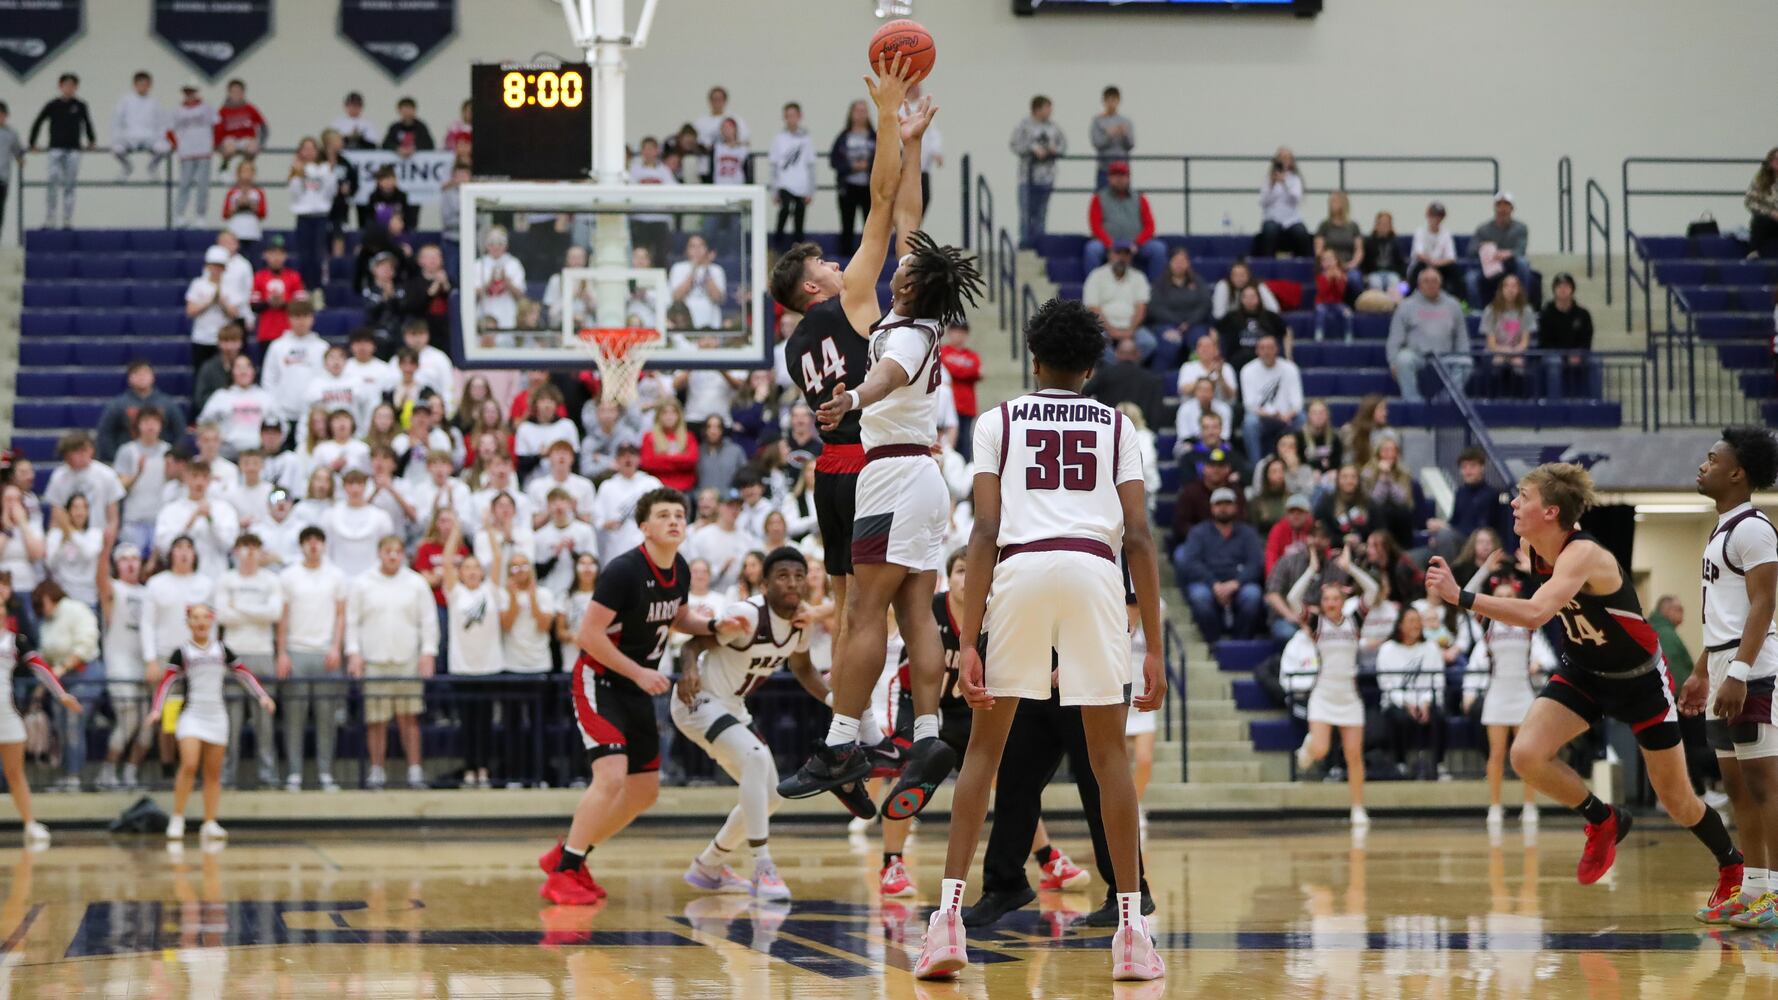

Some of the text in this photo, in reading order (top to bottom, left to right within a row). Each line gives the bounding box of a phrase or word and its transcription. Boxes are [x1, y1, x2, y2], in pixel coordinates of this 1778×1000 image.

[503, 71, 583, 108] 8:00
[801, 336, 847, 394] 44
[1012, 403, 1112, 425] WARRIORS
[1025, 428, 1098, 492] 35
